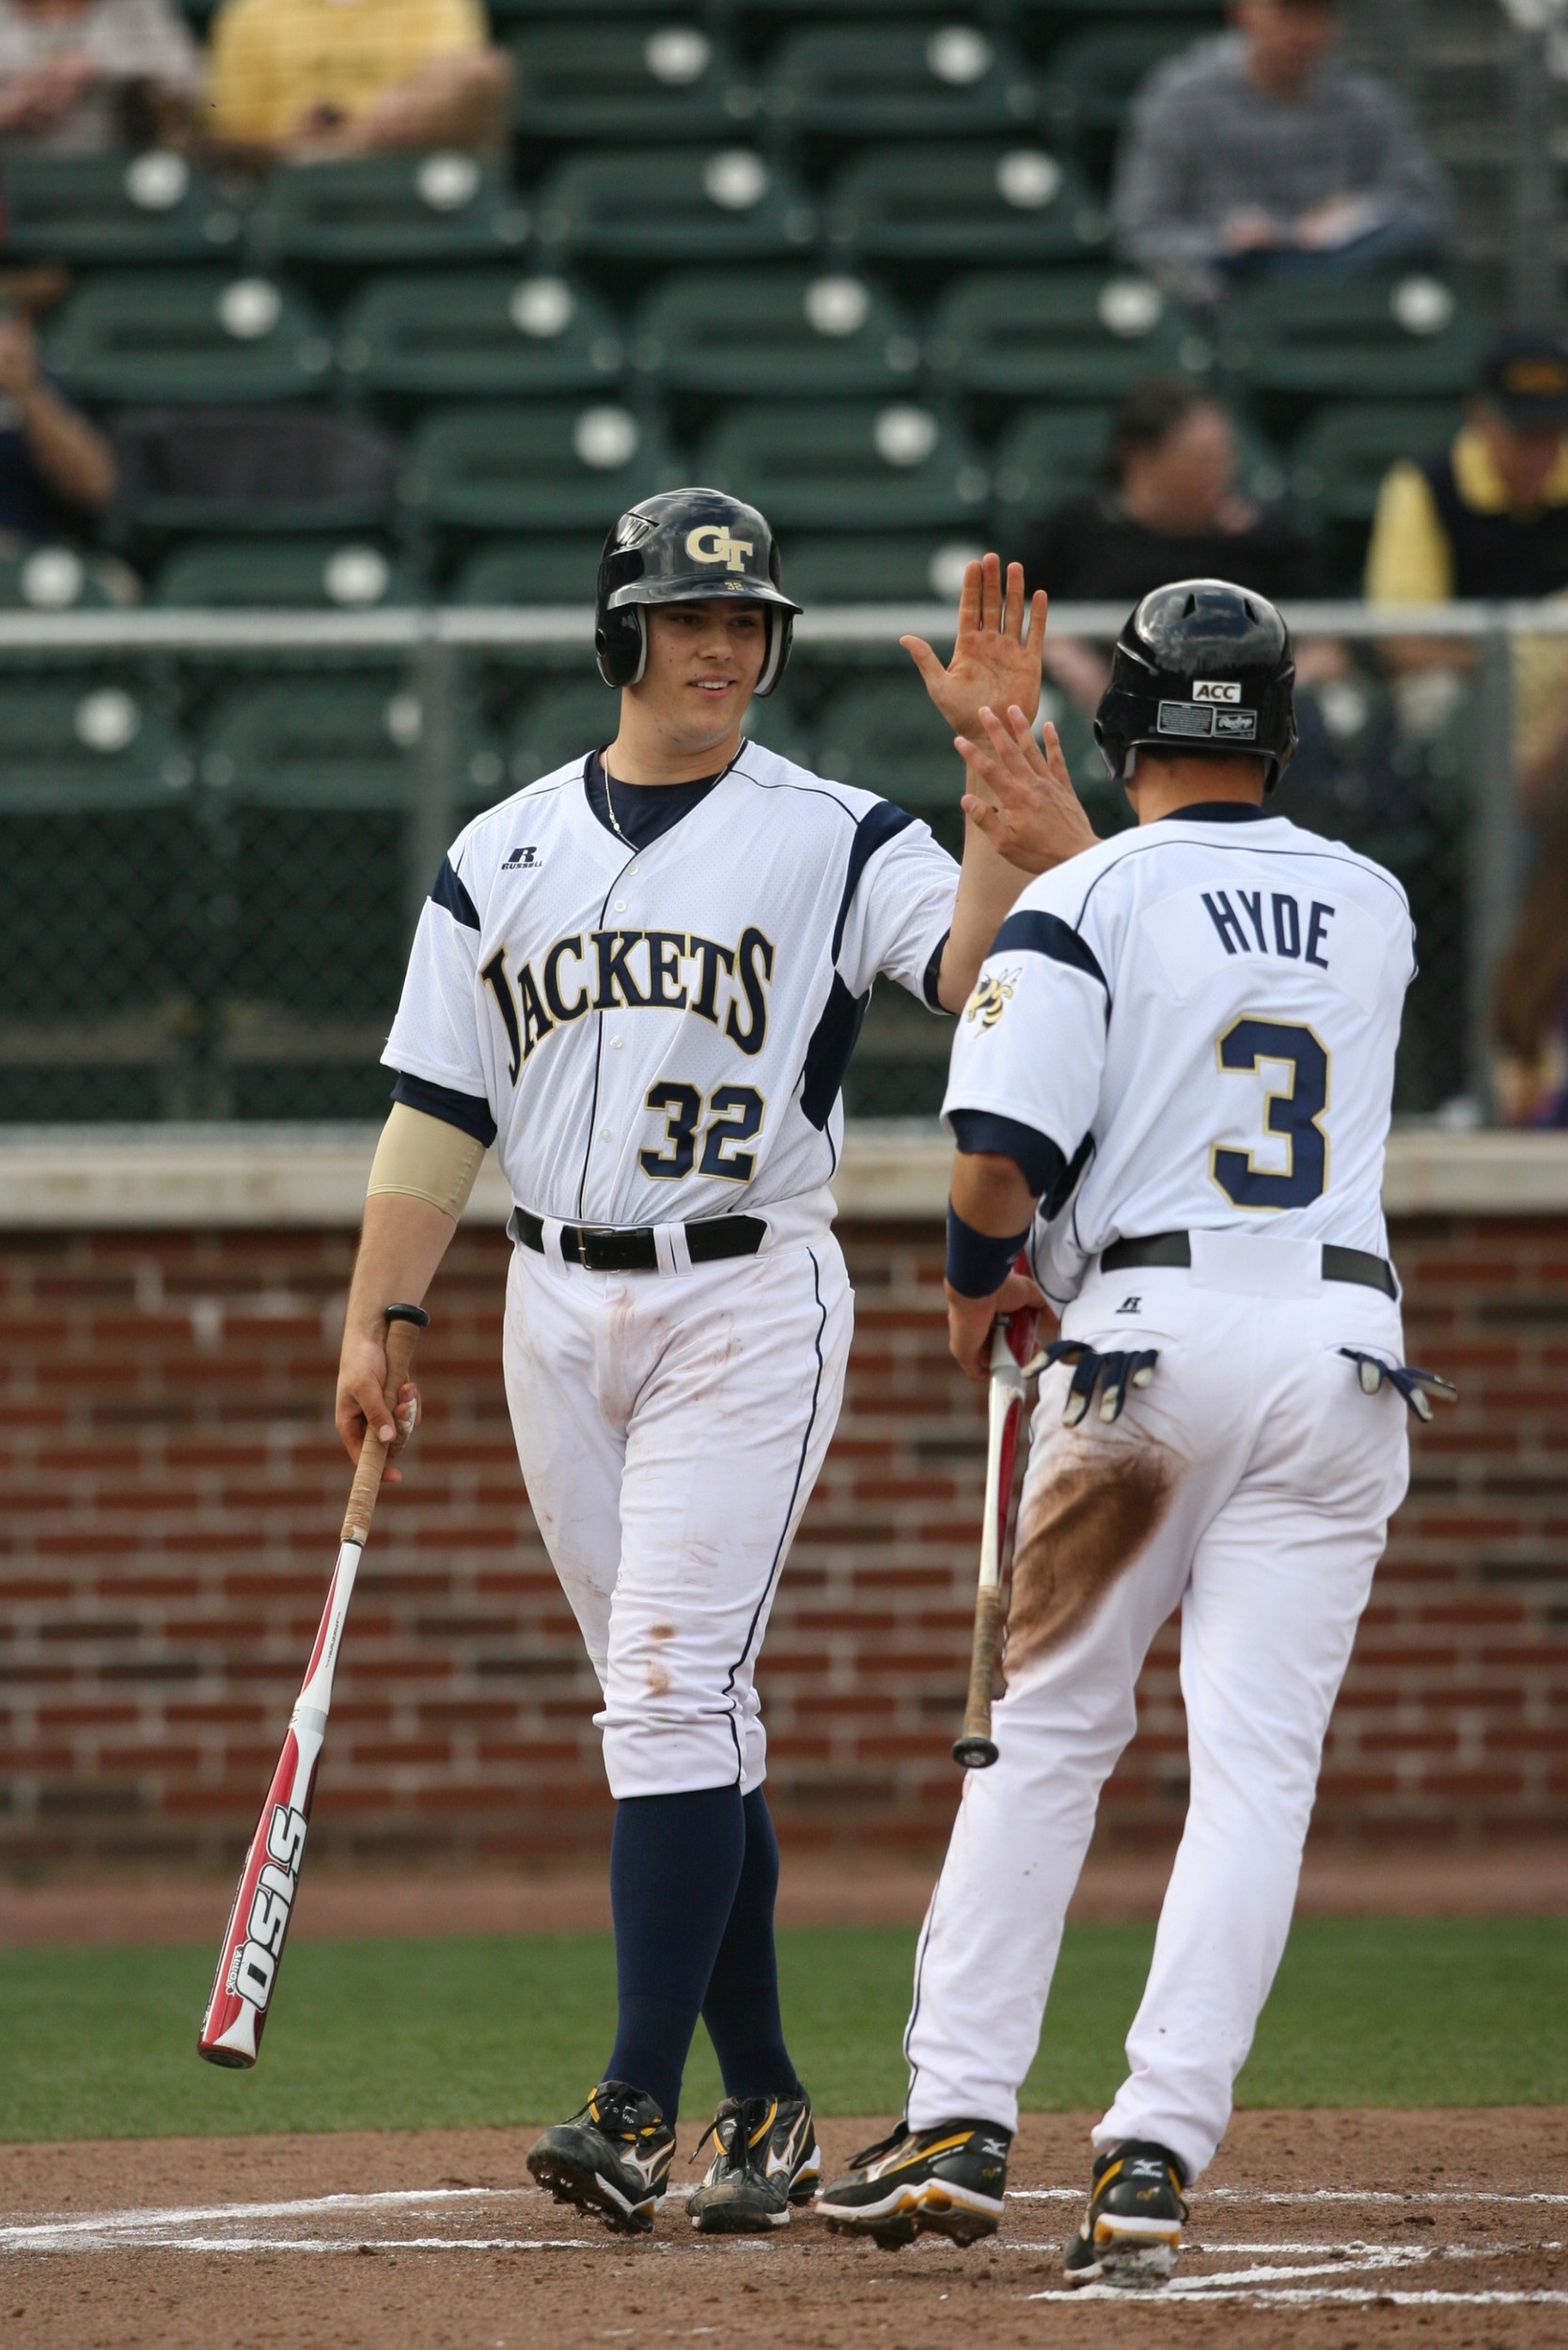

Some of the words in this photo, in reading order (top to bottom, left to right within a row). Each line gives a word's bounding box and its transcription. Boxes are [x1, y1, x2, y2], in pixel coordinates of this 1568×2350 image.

[684, 525, 753, 572] GT
[724, 582, 745, 591] 32
[1195, 684, 1236, 700] ACC
[501, 860, 543, 870] RUSSELL
[1200, 889, 1336, 971] HYDE
[478, 924, 776, 1090] JACKETS
[637, 1079, 767, 1185] 32
[1208, 1012, 1332, 1213] 3
[235, 1804, 308, 2012] 5150
[227, 1950, 243, 1990] ALLOY
